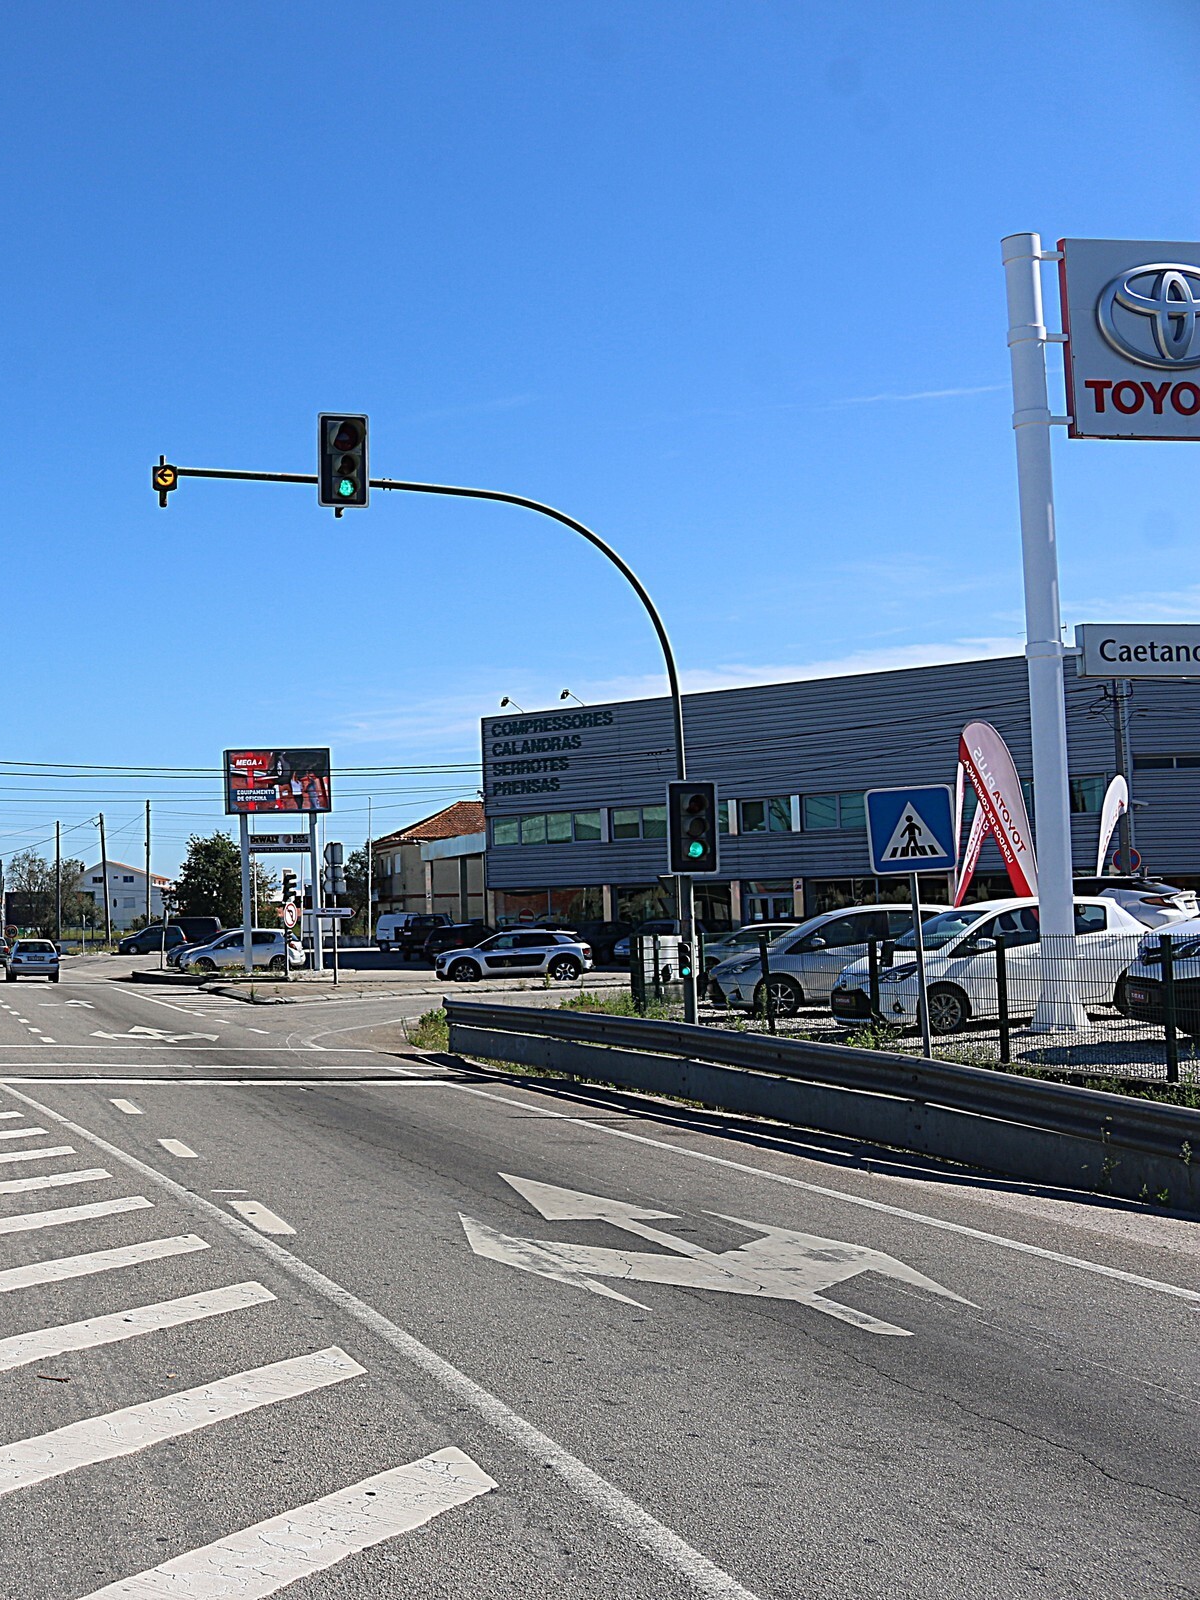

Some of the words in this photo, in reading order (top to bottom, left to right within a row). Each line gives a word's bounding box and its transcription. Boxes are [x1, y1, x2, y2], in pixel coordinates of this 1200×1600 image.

[1084, 380, 1200, 416] TOYO
[491, 710, 613, 738] COMPRESSORES
[491, 734, 582, 757] CALANDRAS
[492, 755, 570, 777] SERROTES
[492, 777, 560, 796] PRENSAS
